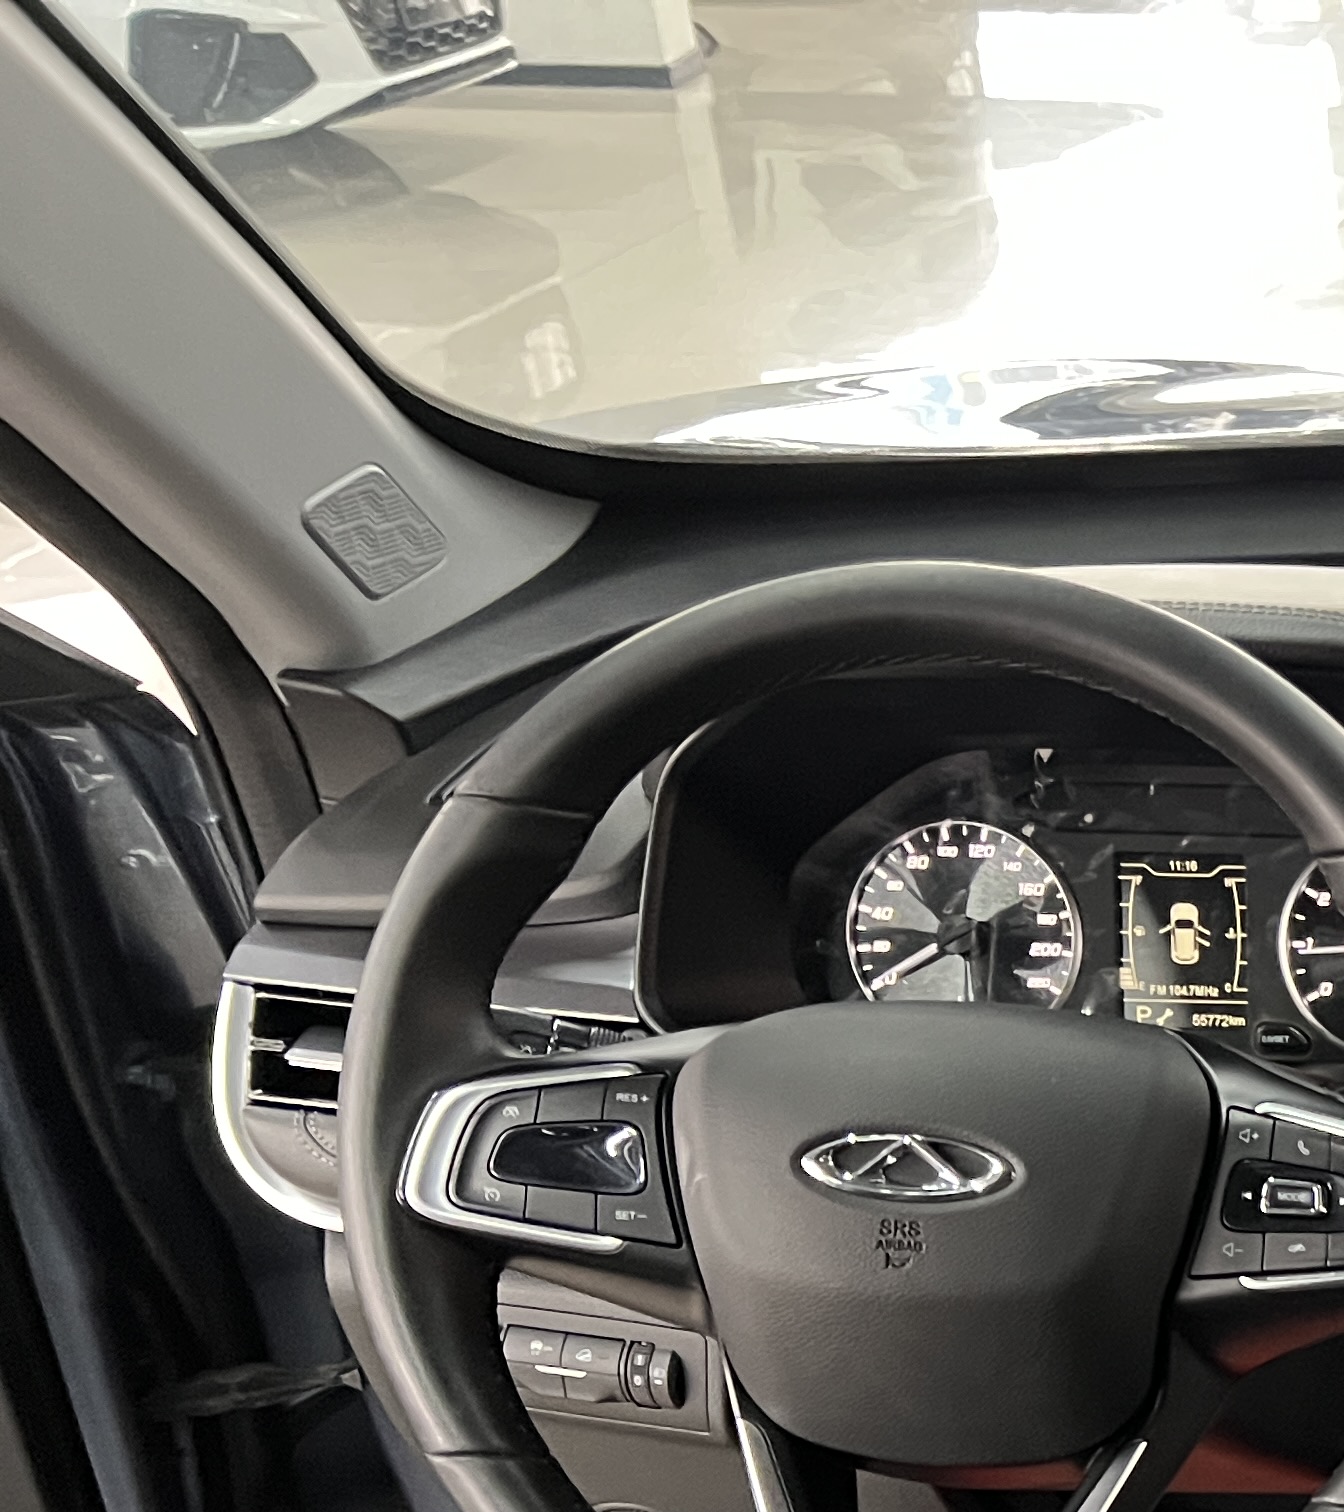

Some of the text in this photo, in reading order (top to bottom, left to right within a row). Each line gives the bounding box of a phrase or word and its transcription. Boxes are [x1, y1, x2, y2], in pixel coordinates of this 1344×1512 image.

[968, 843, 996, 859] 120
[906, 854, 930, 871] 80
[1003, 861, 1022, 872] 140
[1168, 860, 1199, 872] 11:16
[1018, 882, 1045, 897] 160
[871, 907, 894, 921] 40
[1029, 942, 1063, 957] 200
[1149, 984, 1220, 998] FM 104.7MHz
[1135, 1004, 1153, 1023] P
[879, 1218, 921, 1239] SRS
